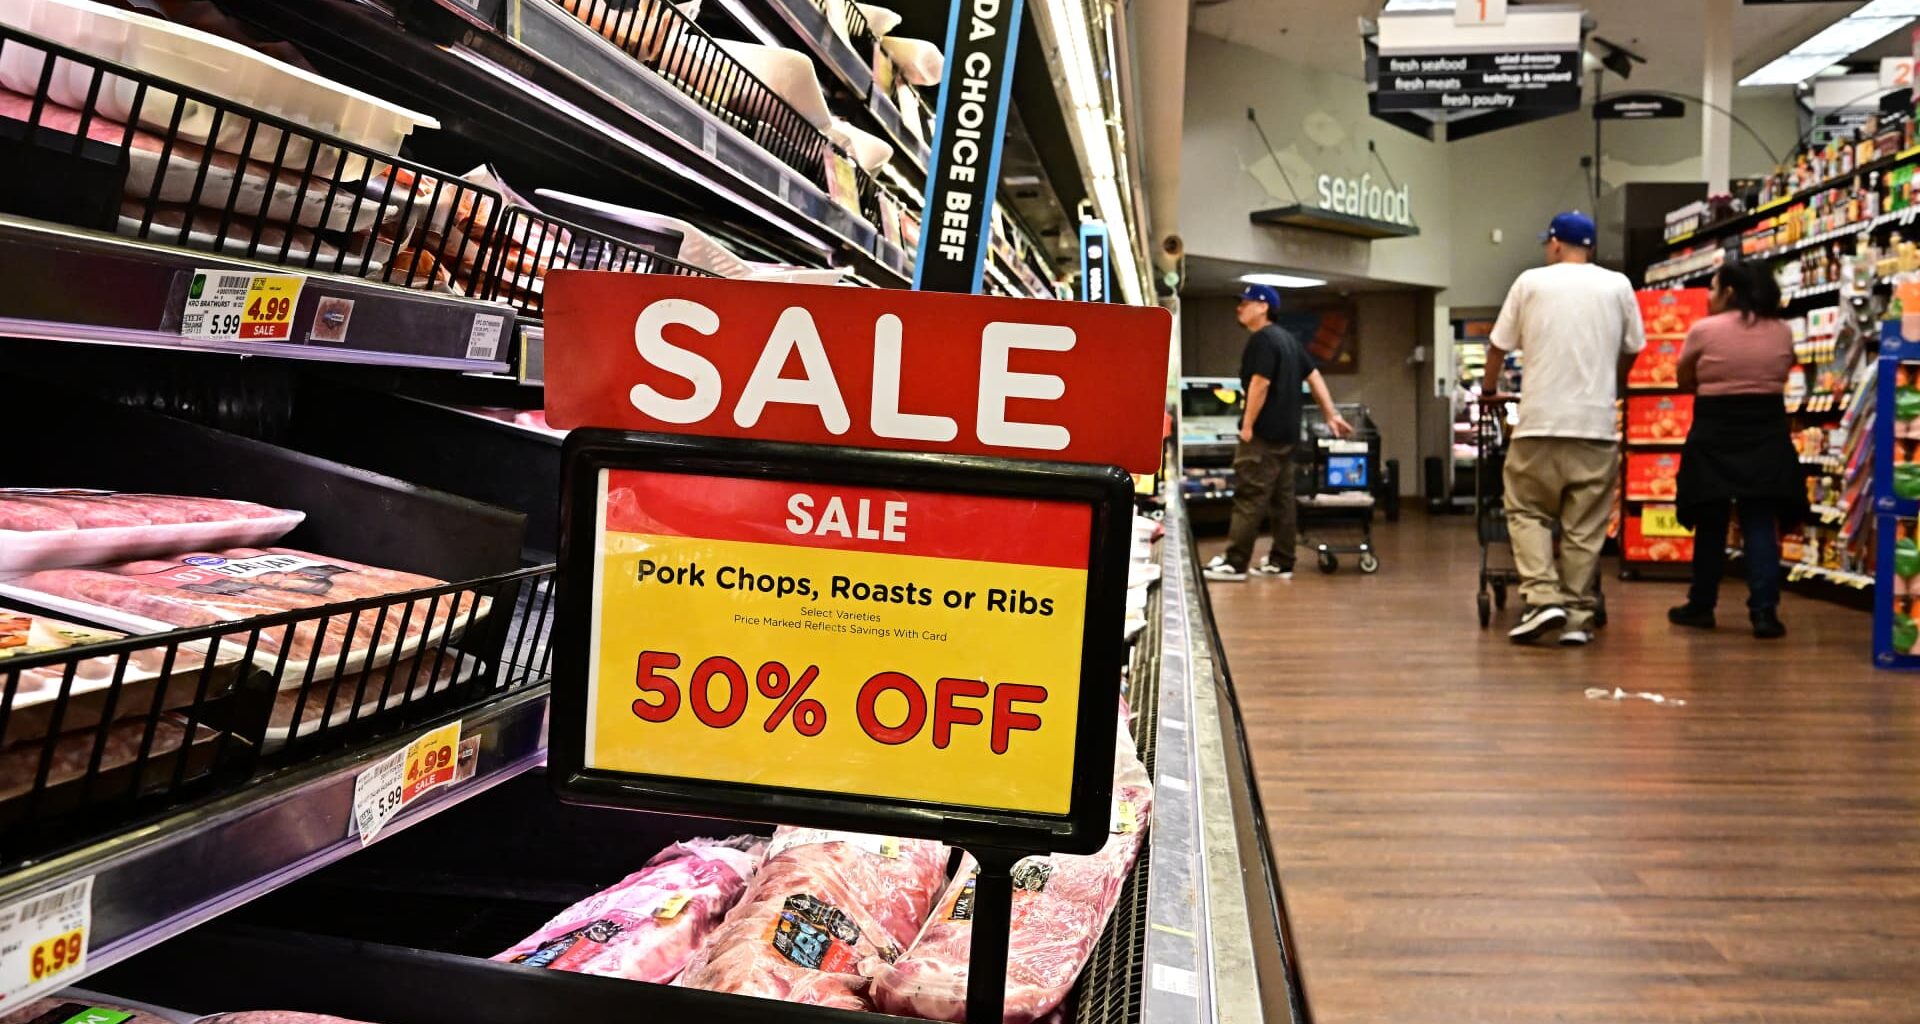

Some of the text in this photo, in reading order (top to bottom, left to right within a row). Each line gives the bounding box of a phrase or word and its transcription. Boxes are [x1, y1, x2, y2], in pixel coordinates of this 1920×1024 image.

[1390, 57, 1467, 72] fresh seafood
[1482, 71, 1572, 84] ketchup & mustard
[1893, 63, 1911, 85] 2
[1395, 77, 1461, 90] fresh meats
[1441, 93, 1515, 108] fresh poultry
[949, 51, 992, 183] CHOICE
[1317, 171, 1409, 226] seafood
[939, 190, 972, 262] BEEF
[247, 296, 290, 320] 4.99
[210, 314, 240, 334] 5.99
[253, 325, 275, 335] SALE
[630, 298, 1077, 451] SALE
[785, 493, 908, 542] SALE
[637, 560, 1055, 616] Pork Chops, Roasts or Ribs
[734, 614, 948, 642] Price Marked Reflects Savings With Card
[800, 606, 881, 622] Select Varieties
[632, 650, 1048, 755] 50% OFF
[407, 745, 452, 780] 4.99
[414, 774, 436, 793] SALE
[378, 785, 402, 817] 5.99
[32, 932, 82, 979] 6.99
